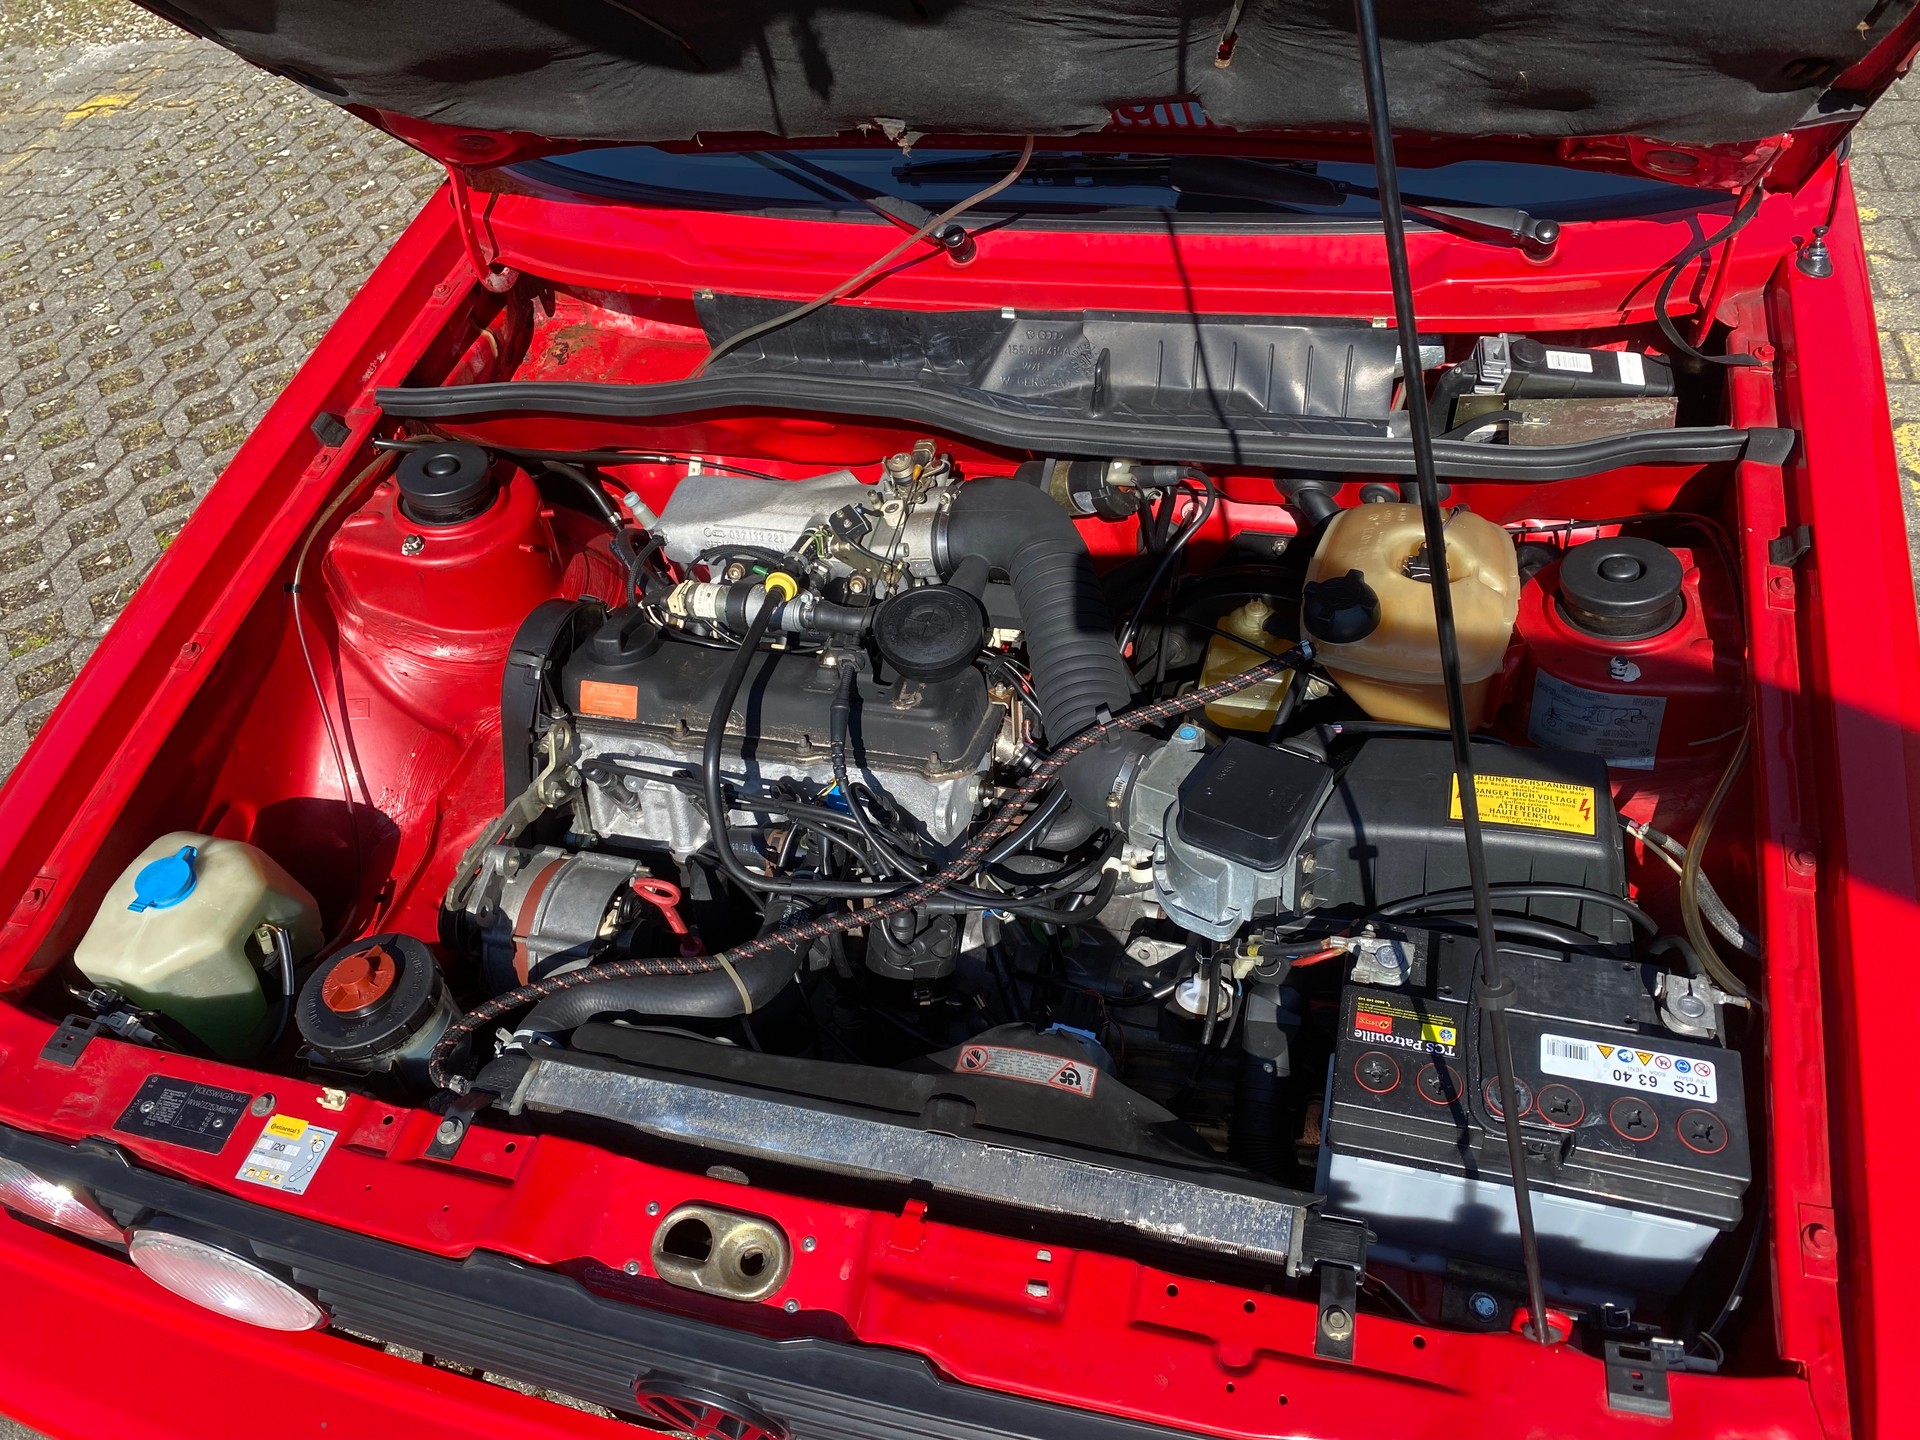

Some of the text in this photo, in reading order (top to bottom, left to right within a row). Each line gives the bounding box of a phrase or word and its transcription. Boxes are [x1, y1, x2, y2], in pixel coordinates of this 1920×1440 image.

[1511, 778, 1585, 791] HOCHSPANNUNG
[1512, 791, 1535, 799] HIGH
[1538, 794, 1578, 804] VOLTAGE
[1490, 808, 1518, 816] HAUTE
[1522, 811, 1560, 821] TENSION
[1354, 1029, 1455, 1057] TCS Patrouille
[1612, 1069, 1711, 1098] TCS 63 40
[194, 1084, 247, 1103] VOLKSWAGEN AG
[271, 1123, 298, 1134] Continental
[271, 1142, 286, 1152] /20
